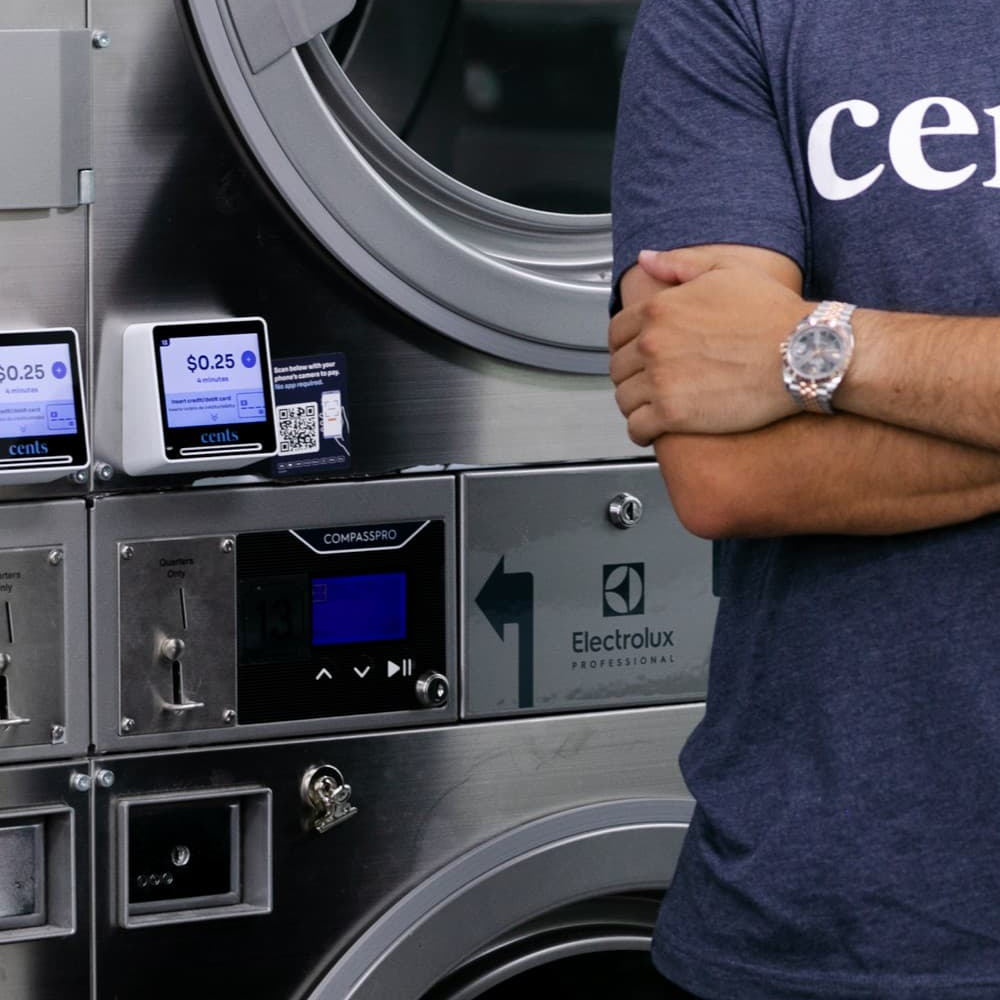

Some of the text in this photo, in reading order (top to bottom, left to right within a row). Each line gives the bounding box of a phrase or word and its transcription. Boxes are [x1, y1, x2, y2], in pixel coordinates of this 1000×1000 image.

[187, 354, 235, 373] $0.25
[274, 361, 336, 374] Scan below with your
[201, 428, 239, 444] cents
[9, 440, 49, 456] cents
[323, 529, 397, 544] COMPASSPRO
[159, 557, 194, 567] Quarters
[167, 569, 185, 579] Only
[572, 627, 674, 653] Electrolux
[572, 654, 675, 670] PROFESSIONAL
